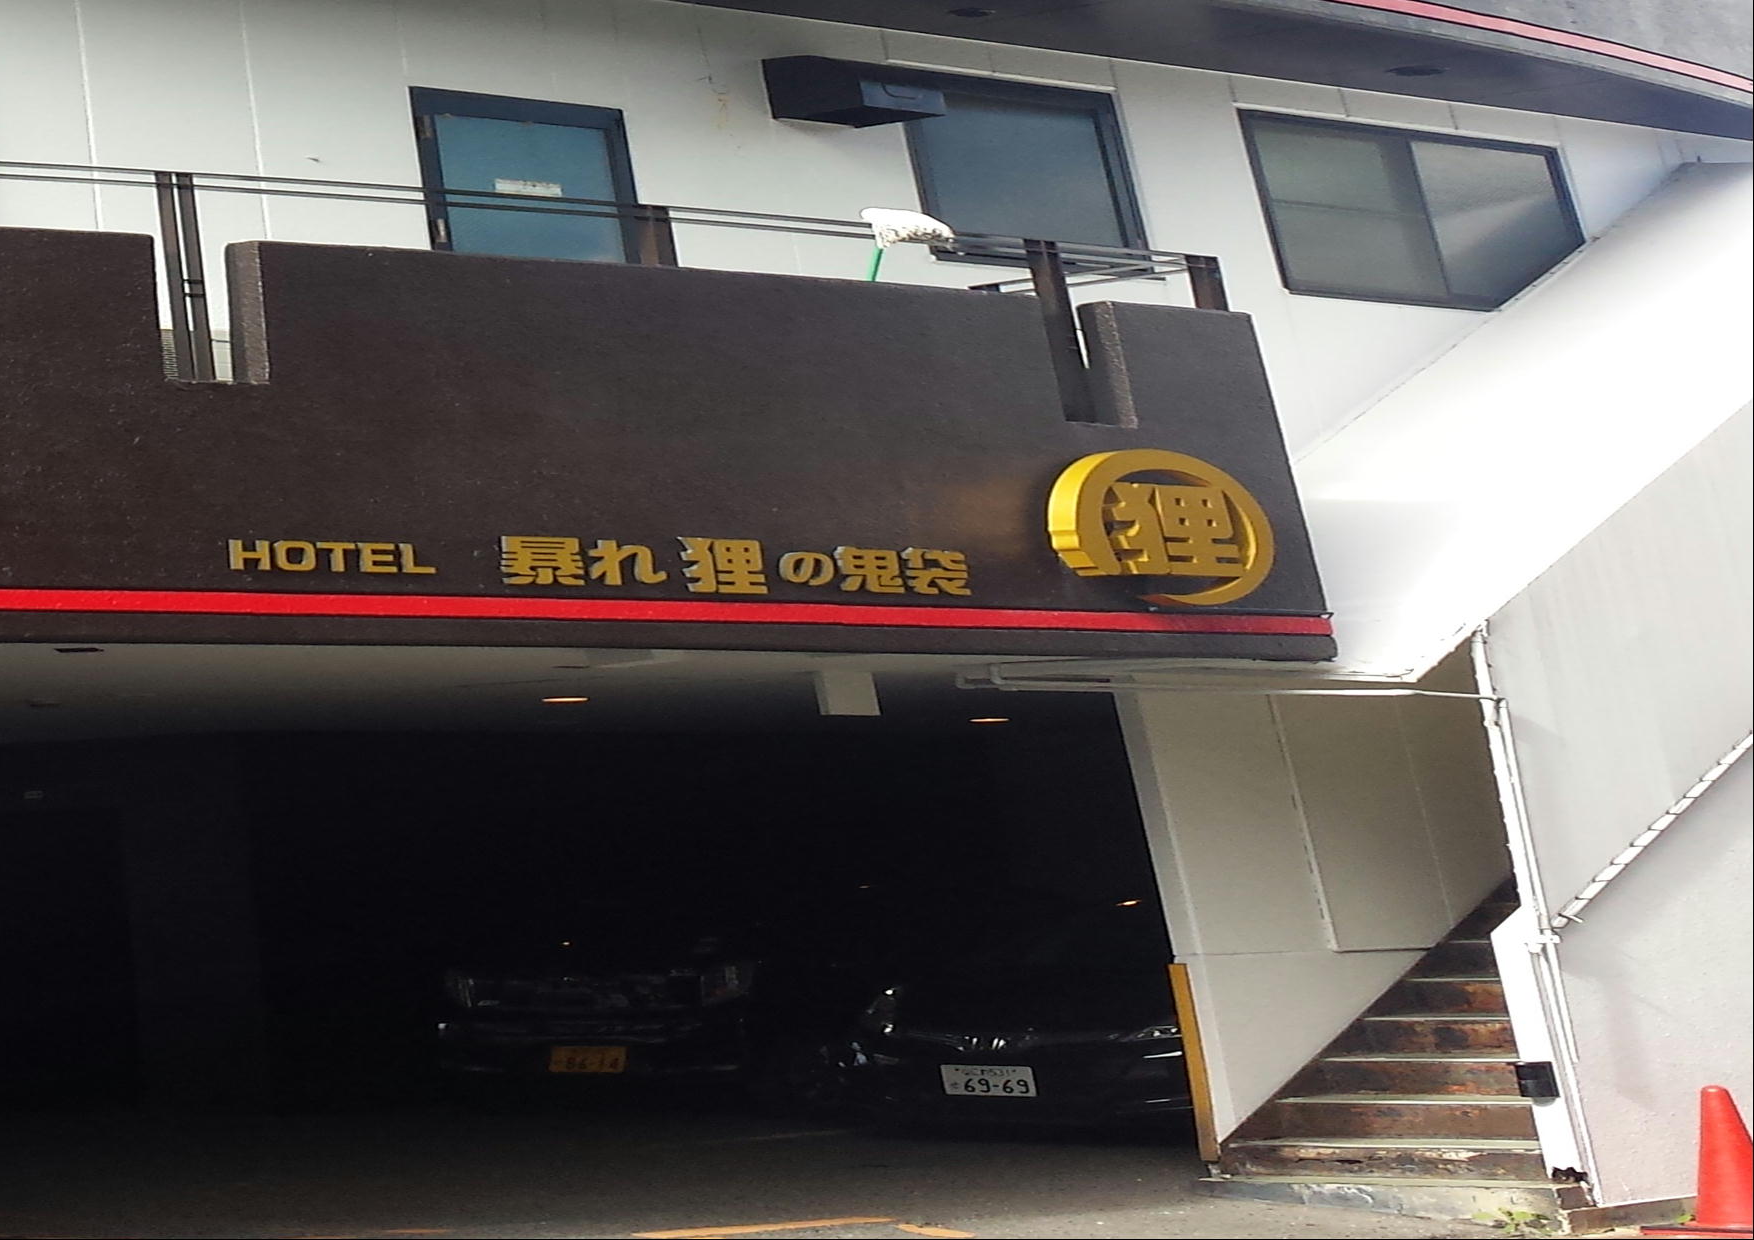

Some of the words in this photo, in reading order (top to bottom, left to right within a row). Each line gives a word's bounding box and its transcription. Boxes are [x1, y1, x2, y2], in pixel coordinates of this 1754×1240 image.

[229, 539, 436, 575] HOTEL
[498, 535, 973, 596] 暴れ狸の鬼袋
[964, 1078, 1030, 1093] 69-69
